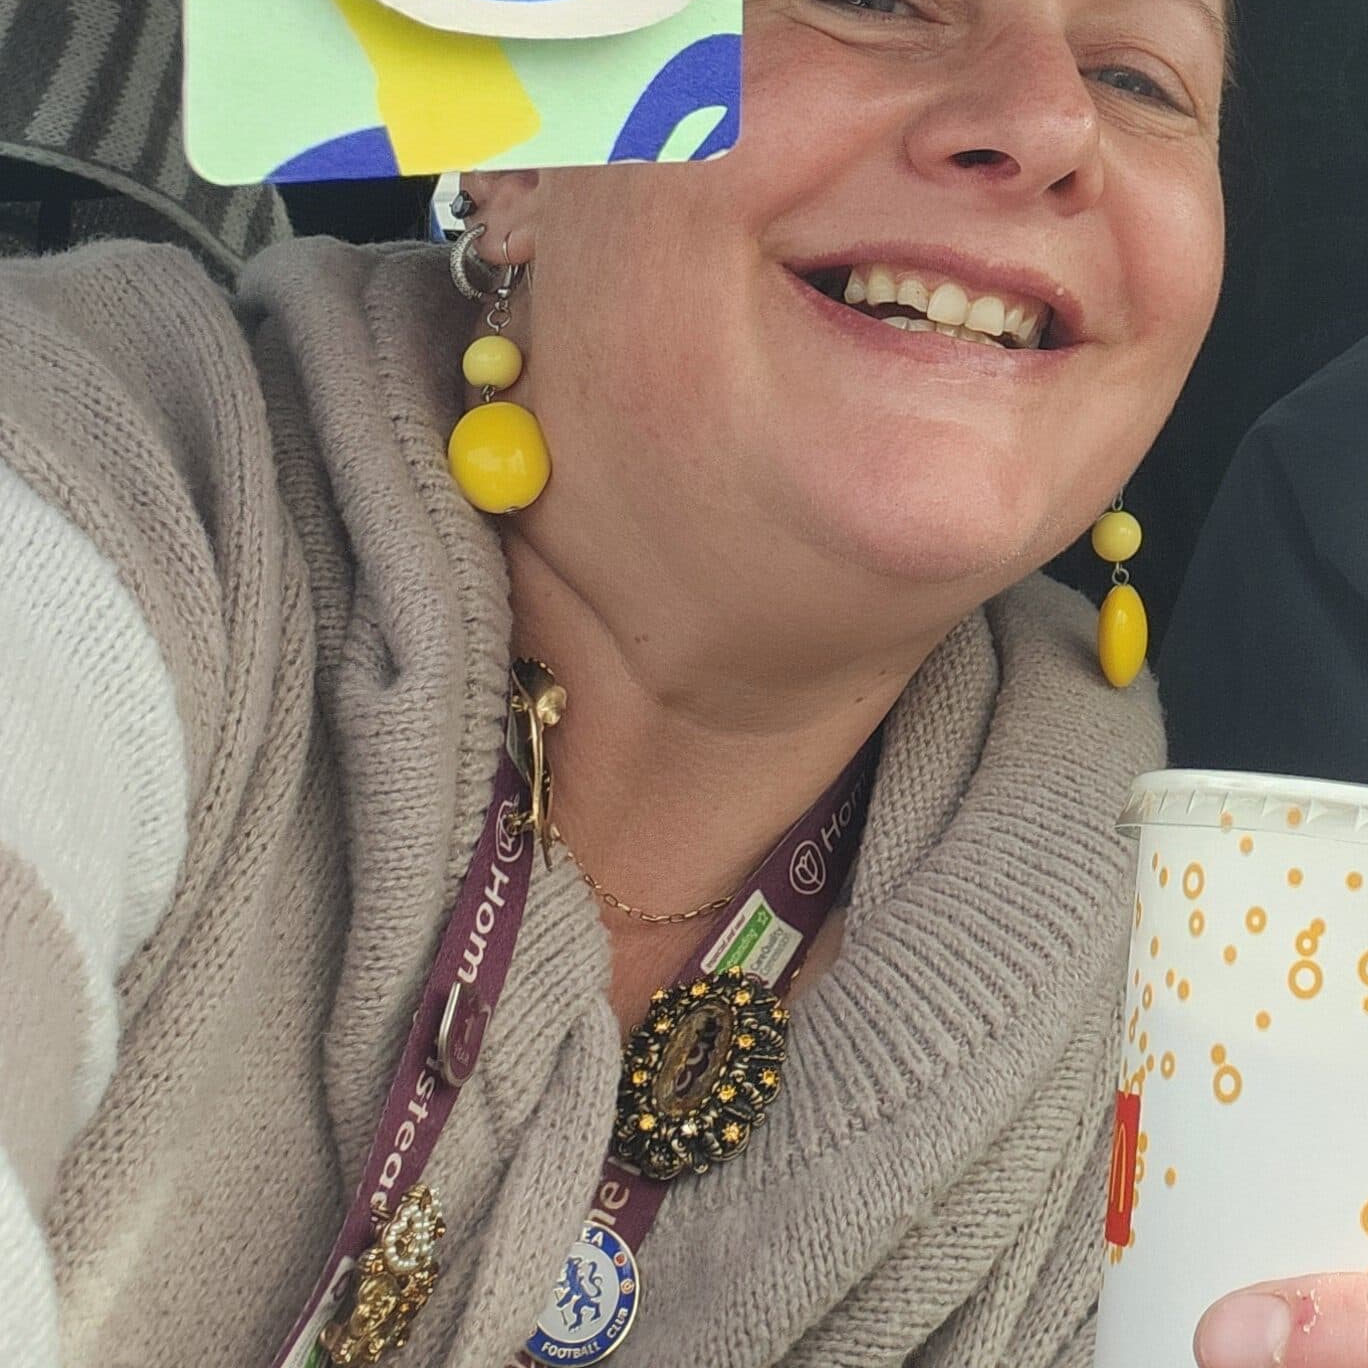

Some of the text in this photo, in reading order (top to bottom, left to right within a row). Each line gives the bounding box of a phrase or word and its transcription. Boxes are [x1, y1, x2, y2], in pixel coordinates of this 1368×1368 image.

[457, 863, 510, 984] Hom
[540, 1308, 629, 1359] FOOTBALL CLUB
